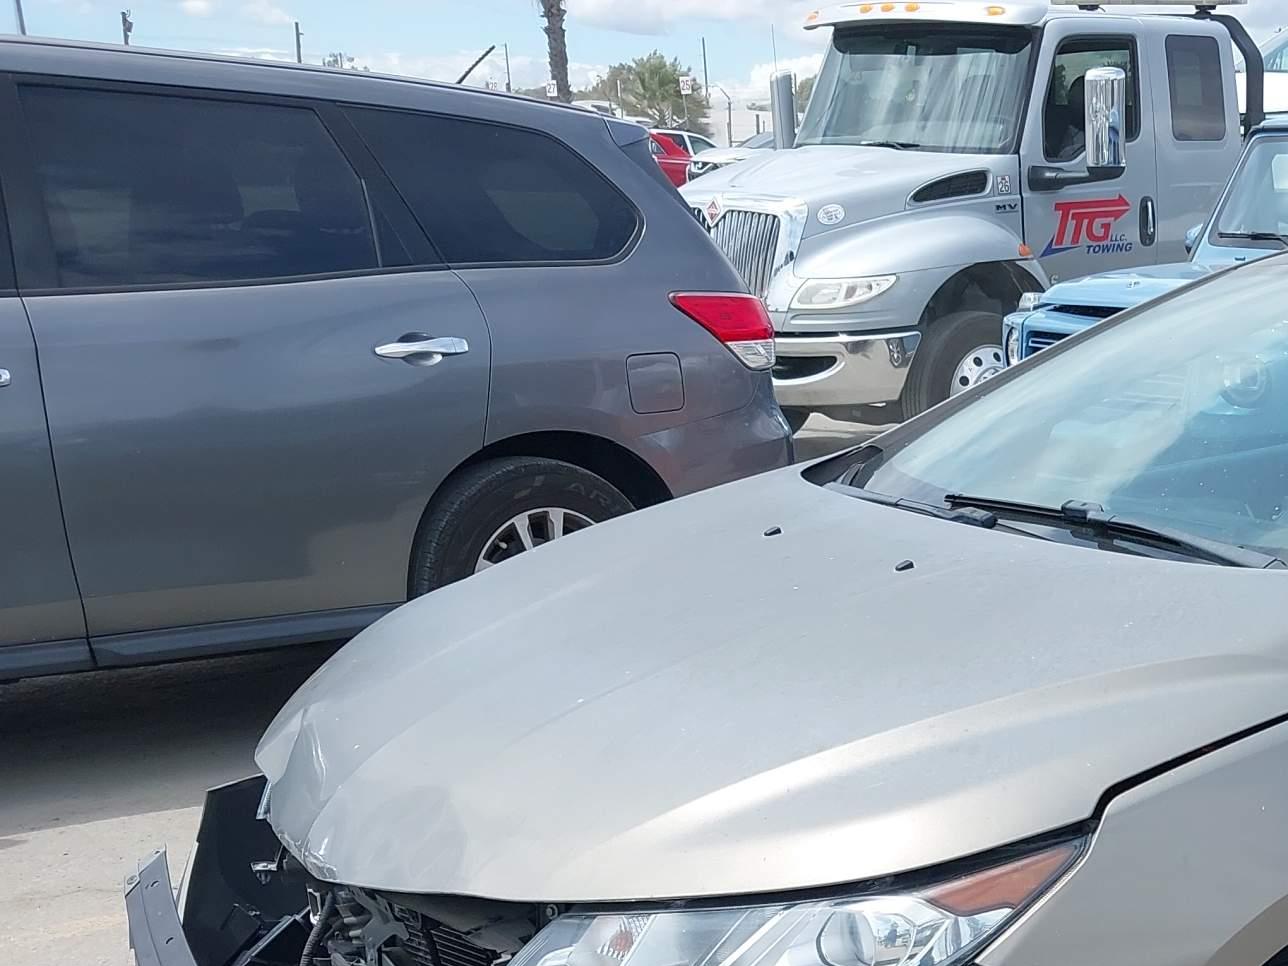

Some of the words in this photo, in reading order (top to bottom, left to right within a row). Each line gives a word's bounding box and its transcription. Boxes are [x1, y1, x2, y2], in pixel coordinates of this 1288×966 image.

[681, 80, 691, 91] 25
[999, 181, 1010, 193] 26
[1086, 243, 1133, 255] TOWING
